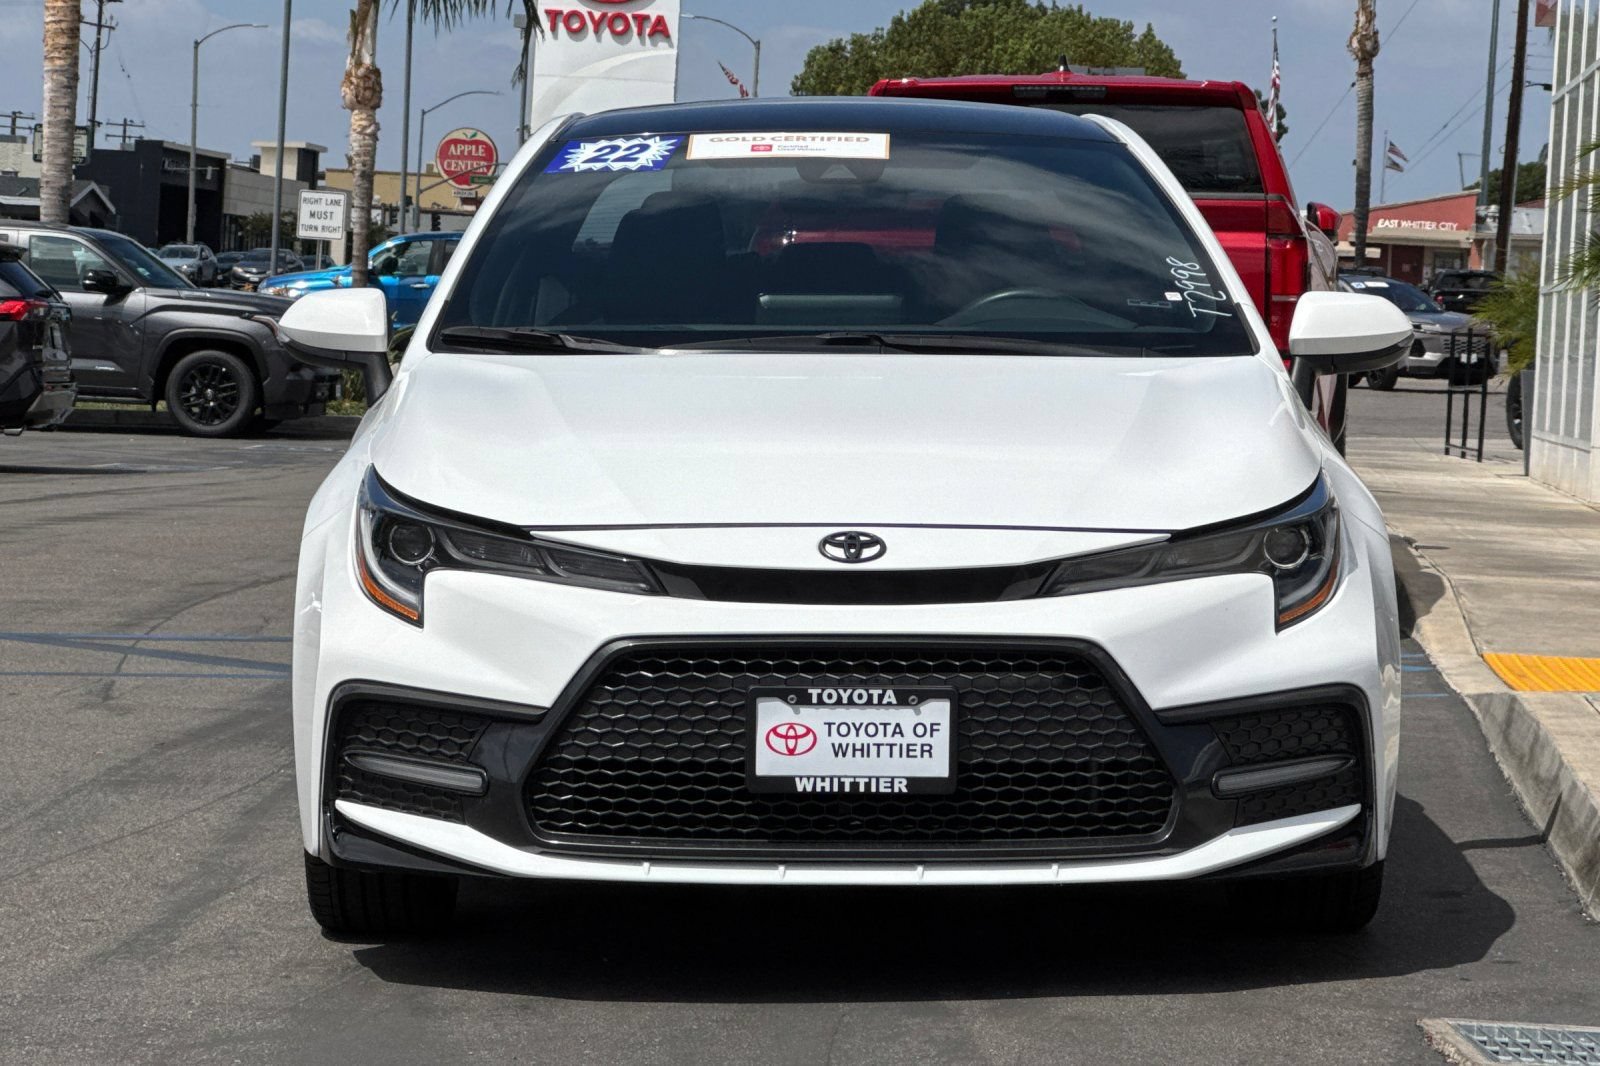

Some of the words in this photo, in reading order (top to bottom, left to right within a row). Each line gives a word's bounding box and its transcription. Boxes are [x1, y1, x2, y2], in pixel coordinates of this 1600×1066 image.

[544, 9, 671, 39] TOYOTA
[770, 135, 870, 143] CERTIFIED
[448, 143, 486, 157] APPLE
[580, 144, 652, 164] 22
[443, 159, 488, 173] CENTER
[302, 197, 323, 206] RIGHT
[325, 198, 343, 207] LANE
[309, 210, 335, 221] MUST
[301, 223, 319, 233] TURN
[320, 225, 342, 234] RIGHT
[1377, 218, 1399, 228] EAST
[1400, 219, 1438, 230] WHITTIER
[1439, 221, 1459, 231] CITY
[807, 688, 898, 705] TOYOTA
[823, 721, 905, 739] TOYOTA
[911, 722, 942, 739] OF
[831, 742, 934, 759] WHITTIER
[794, 776, 909, 794] WHITTIER
